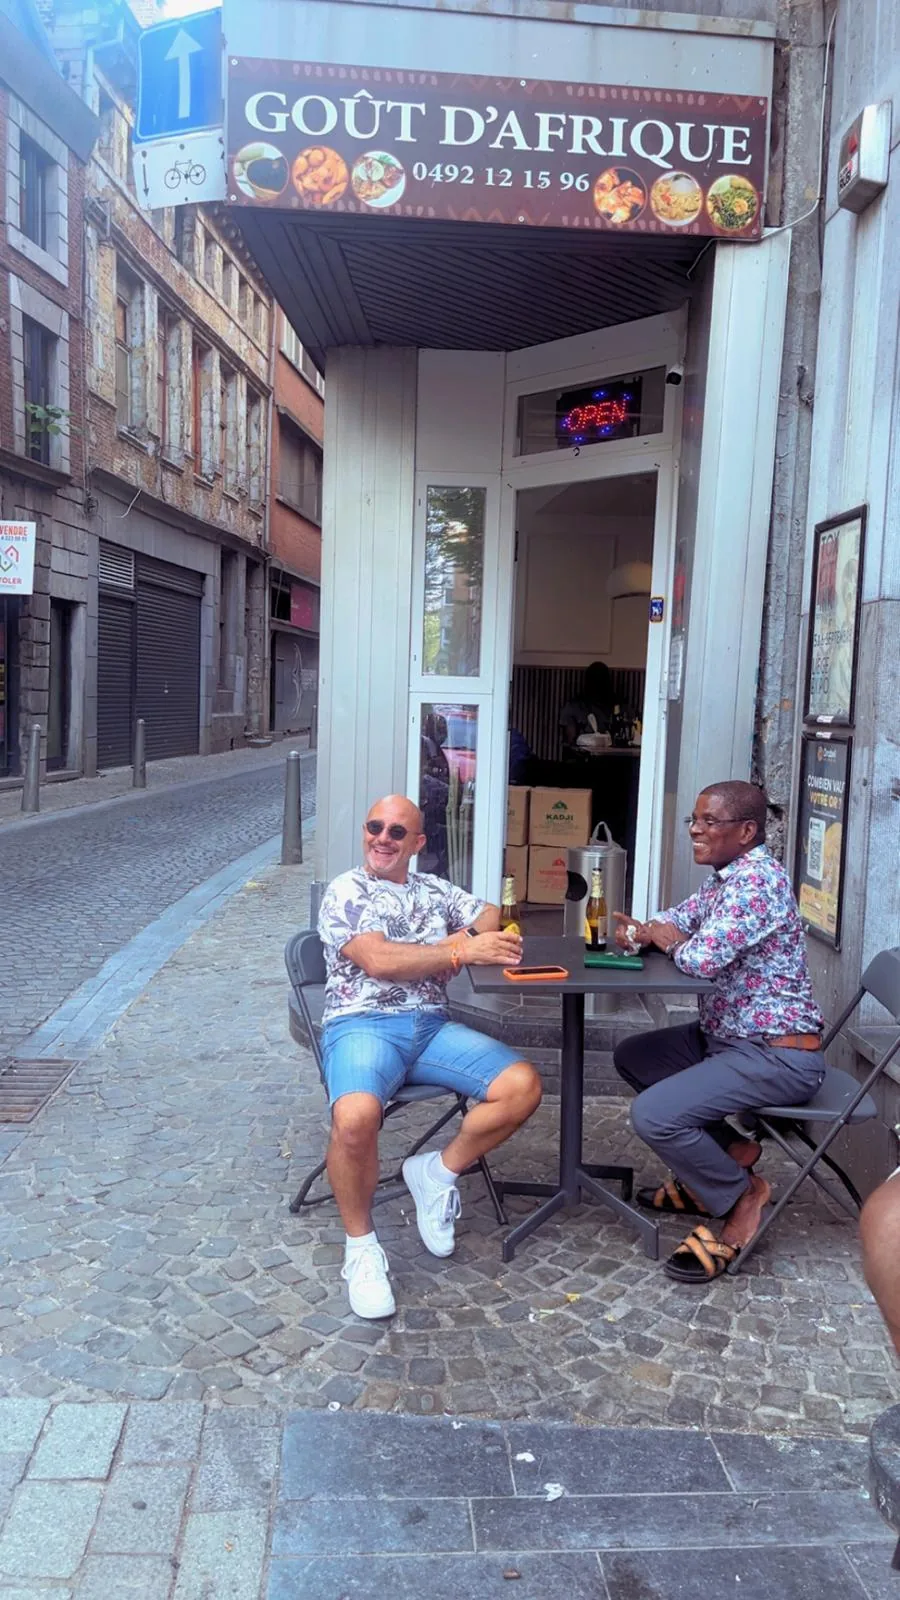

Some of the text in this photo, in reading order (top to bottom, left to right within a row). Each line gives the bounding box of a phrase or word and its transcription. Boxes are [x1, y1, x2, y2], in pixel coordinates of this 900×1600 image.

[244, 88, 752, 169] GOÛT D’AFRIQUE
[412, 161, 591, 192] 0492 12 15 96
[566, 394, 627, 431] OPEN
[808, 775, 832, 791] COMBIEN
[810, 791, 828, 807] VOTRE
